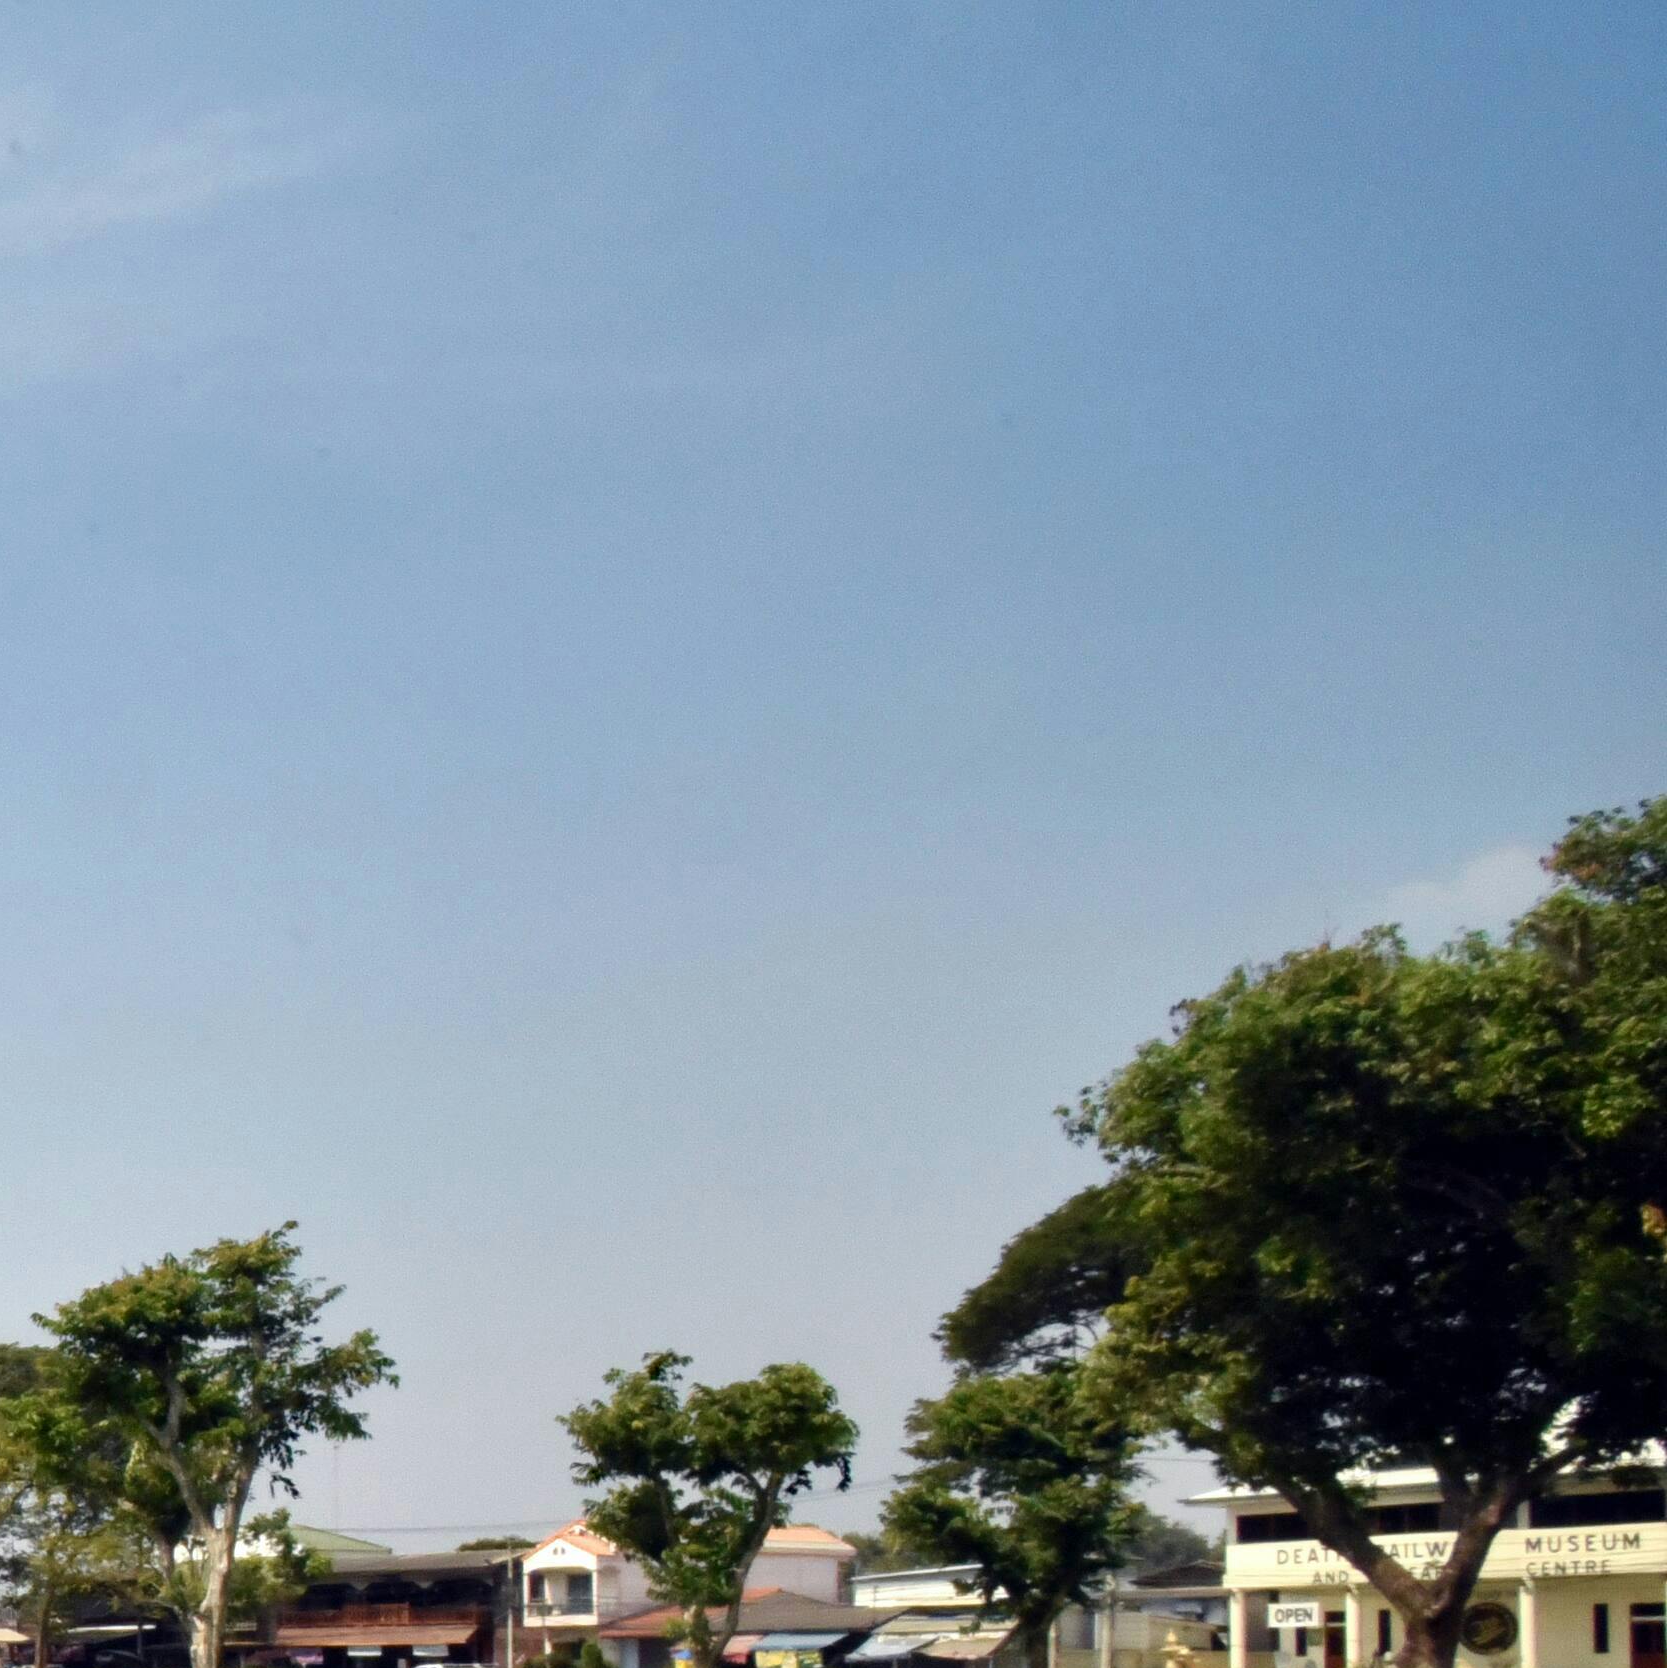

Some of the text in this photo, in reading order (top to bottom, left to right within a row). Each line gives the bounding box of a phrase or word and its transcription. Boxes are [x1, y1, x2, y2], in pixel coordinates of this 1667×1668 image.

[1525, 1532, 1640, 1553] MUSEUM
[1313, 1559, 1611, 1585] AND CENTRE
[1274, 1607, 1313, 1623] OPEN
